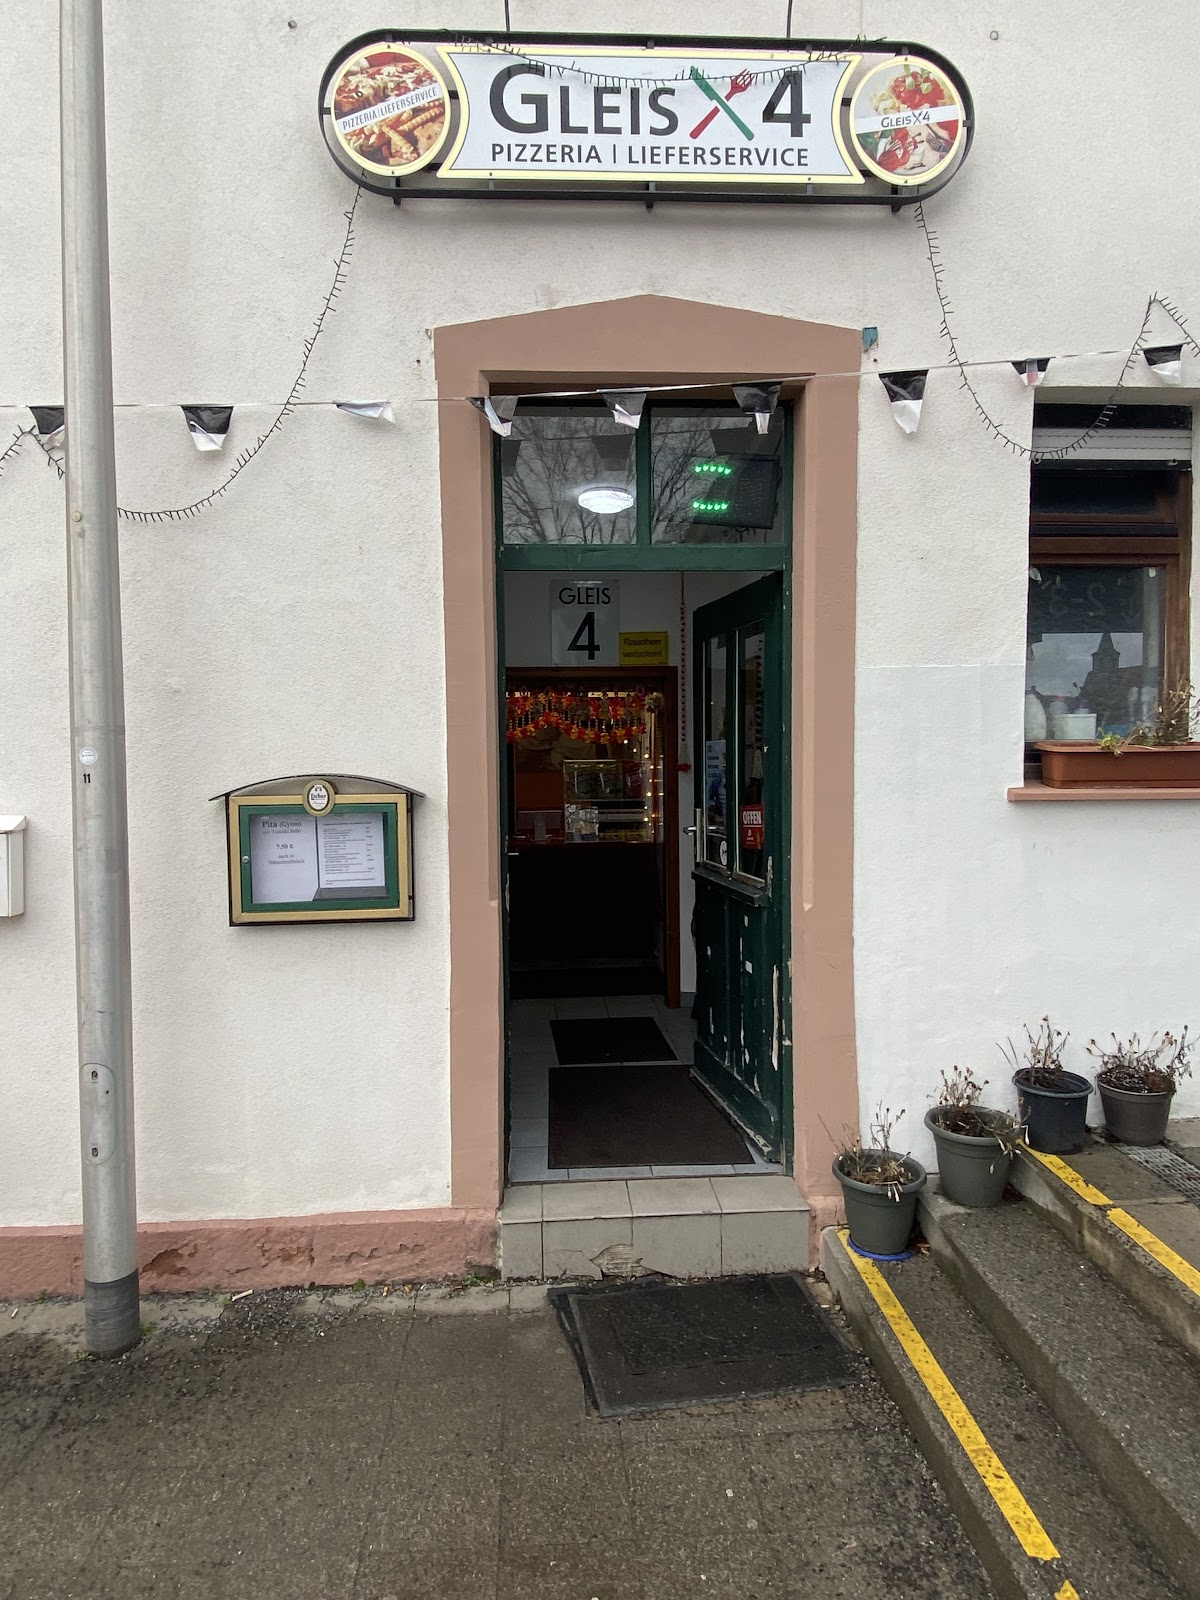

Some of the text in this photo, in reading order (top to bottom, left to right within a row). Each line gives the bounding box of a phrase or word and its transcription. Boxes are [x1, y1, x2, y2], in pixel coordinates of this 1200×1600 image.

[342, 86, 438, 131] PIZZERIA LIEFERSERVICE
[762, 70, 811, 137] 4
[922, 111, 931, 121] 4
[491, 143, 808, 167] PIZZERIA LIEFERSERVICE
[558, 587, 611, 605] GLEIS
[566, 611, 600, 660] 4
[82, 773, 91, 784] 11
[742, 811, 762, 825] OFFEN
